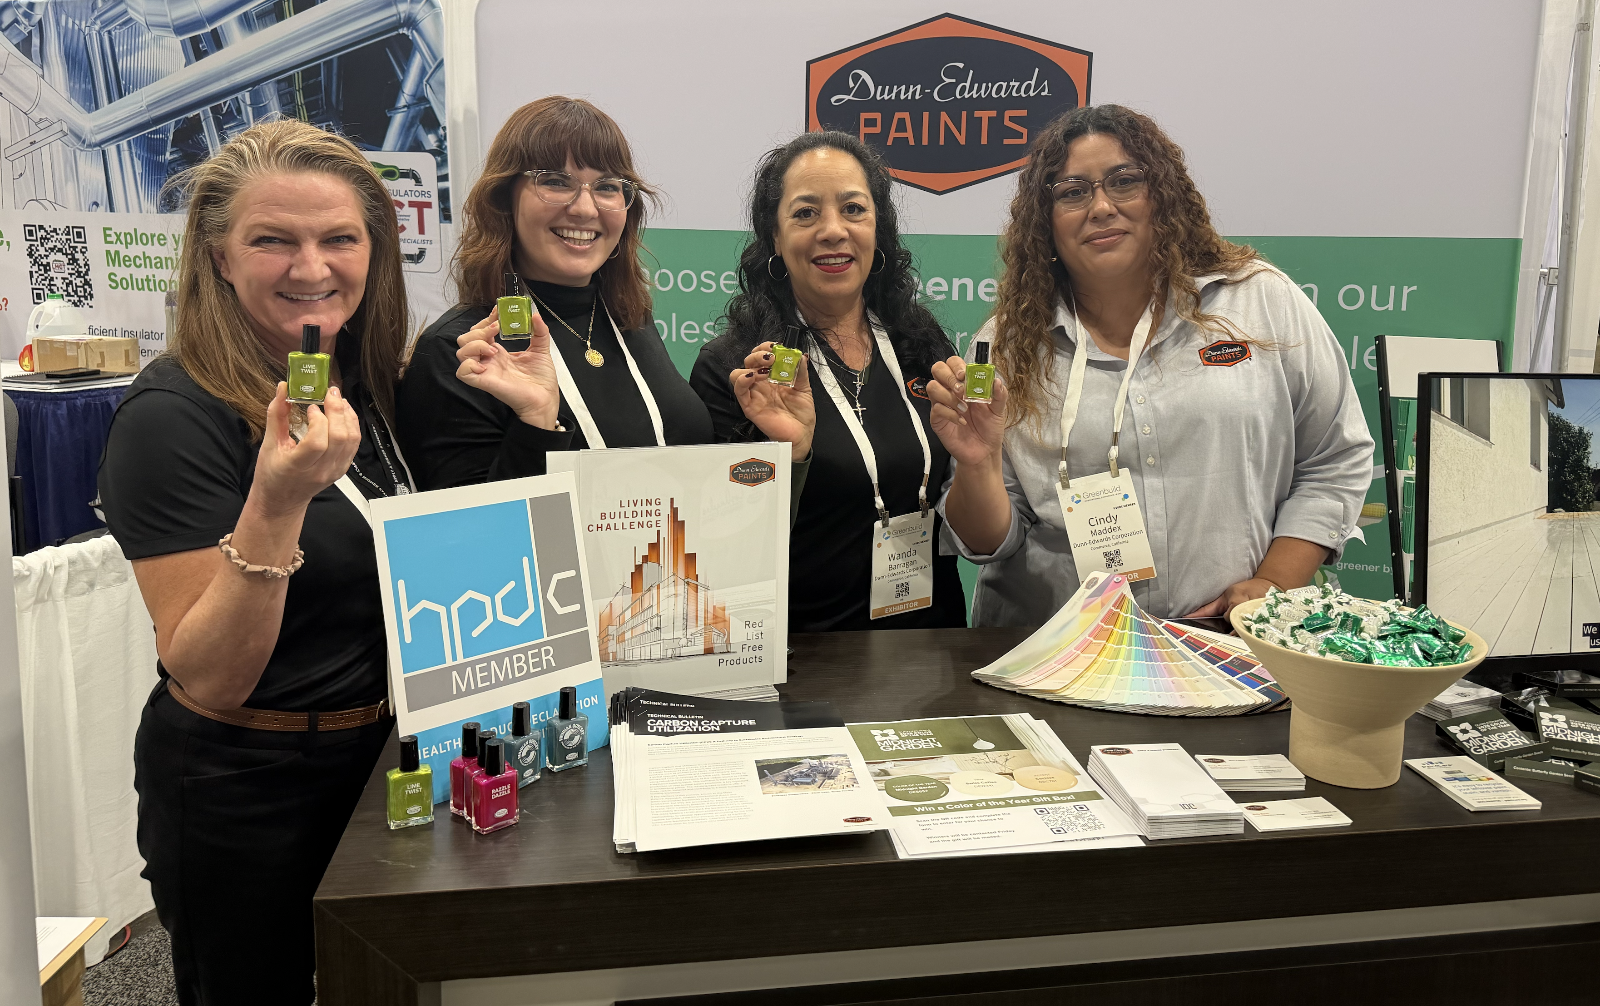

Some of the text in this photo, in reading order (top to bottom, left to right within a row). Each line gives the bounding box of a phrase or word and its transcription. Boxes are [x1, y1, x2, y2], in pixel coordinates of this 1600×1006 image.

[830, 62, 1052, 106] Dunn-Edwards
[859, 109, 1028, 146] PAINTS
[102, 226, 167, 249] Explore
[1337, 284, 1418, 312] our
[121, 326, 165, 341] Insulator
[1211, 351, 1242, 362] PAINTS
[738, 472, 767, 480] PAINTS
[619, 498, 662, 508] LIVING
[600, 508, 662, 521] BUILDING
[1088, 513, 1118, 527] Cindy
[587, 519, 661, 533] CHALLENGE
[1090, 525, 1122, 537] Maddex
[887, 547, 917, 562] Wanda
[888, 559, 918, 572] Barragan
[1336, 561, 1380, 572] greener
[884, 601, 919, 614] EXHIBITOR
[744, 619, 764, 630] Red
[1583, 625, 1598, 635] We
[746, 630, 764, 641] List
[741, 643, 763, 653] Free
[718, 654, 763, 667] Products
[451, 645, 556, 695] MEMBER
[646, 718, 757, 727] CARBON CAPTURE
[647, 725, 720, 733] UTILIZATION
[876, 737, 937, 748] MIDNIGHT
[1462, 729, 1520, 749] MIDNIGHT
[879, 741, 943, 752] GARDEN
[1470, 736, 1530, 755] GARDEN
[405, 787, 422, 795] TWIST
[406, 782, 421, 790] LIME
[491, 783, 511, 794] RAZZLE
[491, 789, 511, 800] DAZZLE
[914, 805, 936, 813] Win
[945, 802, 974, 810] Color
[989, 799, 1006, 807] the
[1008, 797, 1030, 805] Year
[1032, 795, 1051, 803] Gift
